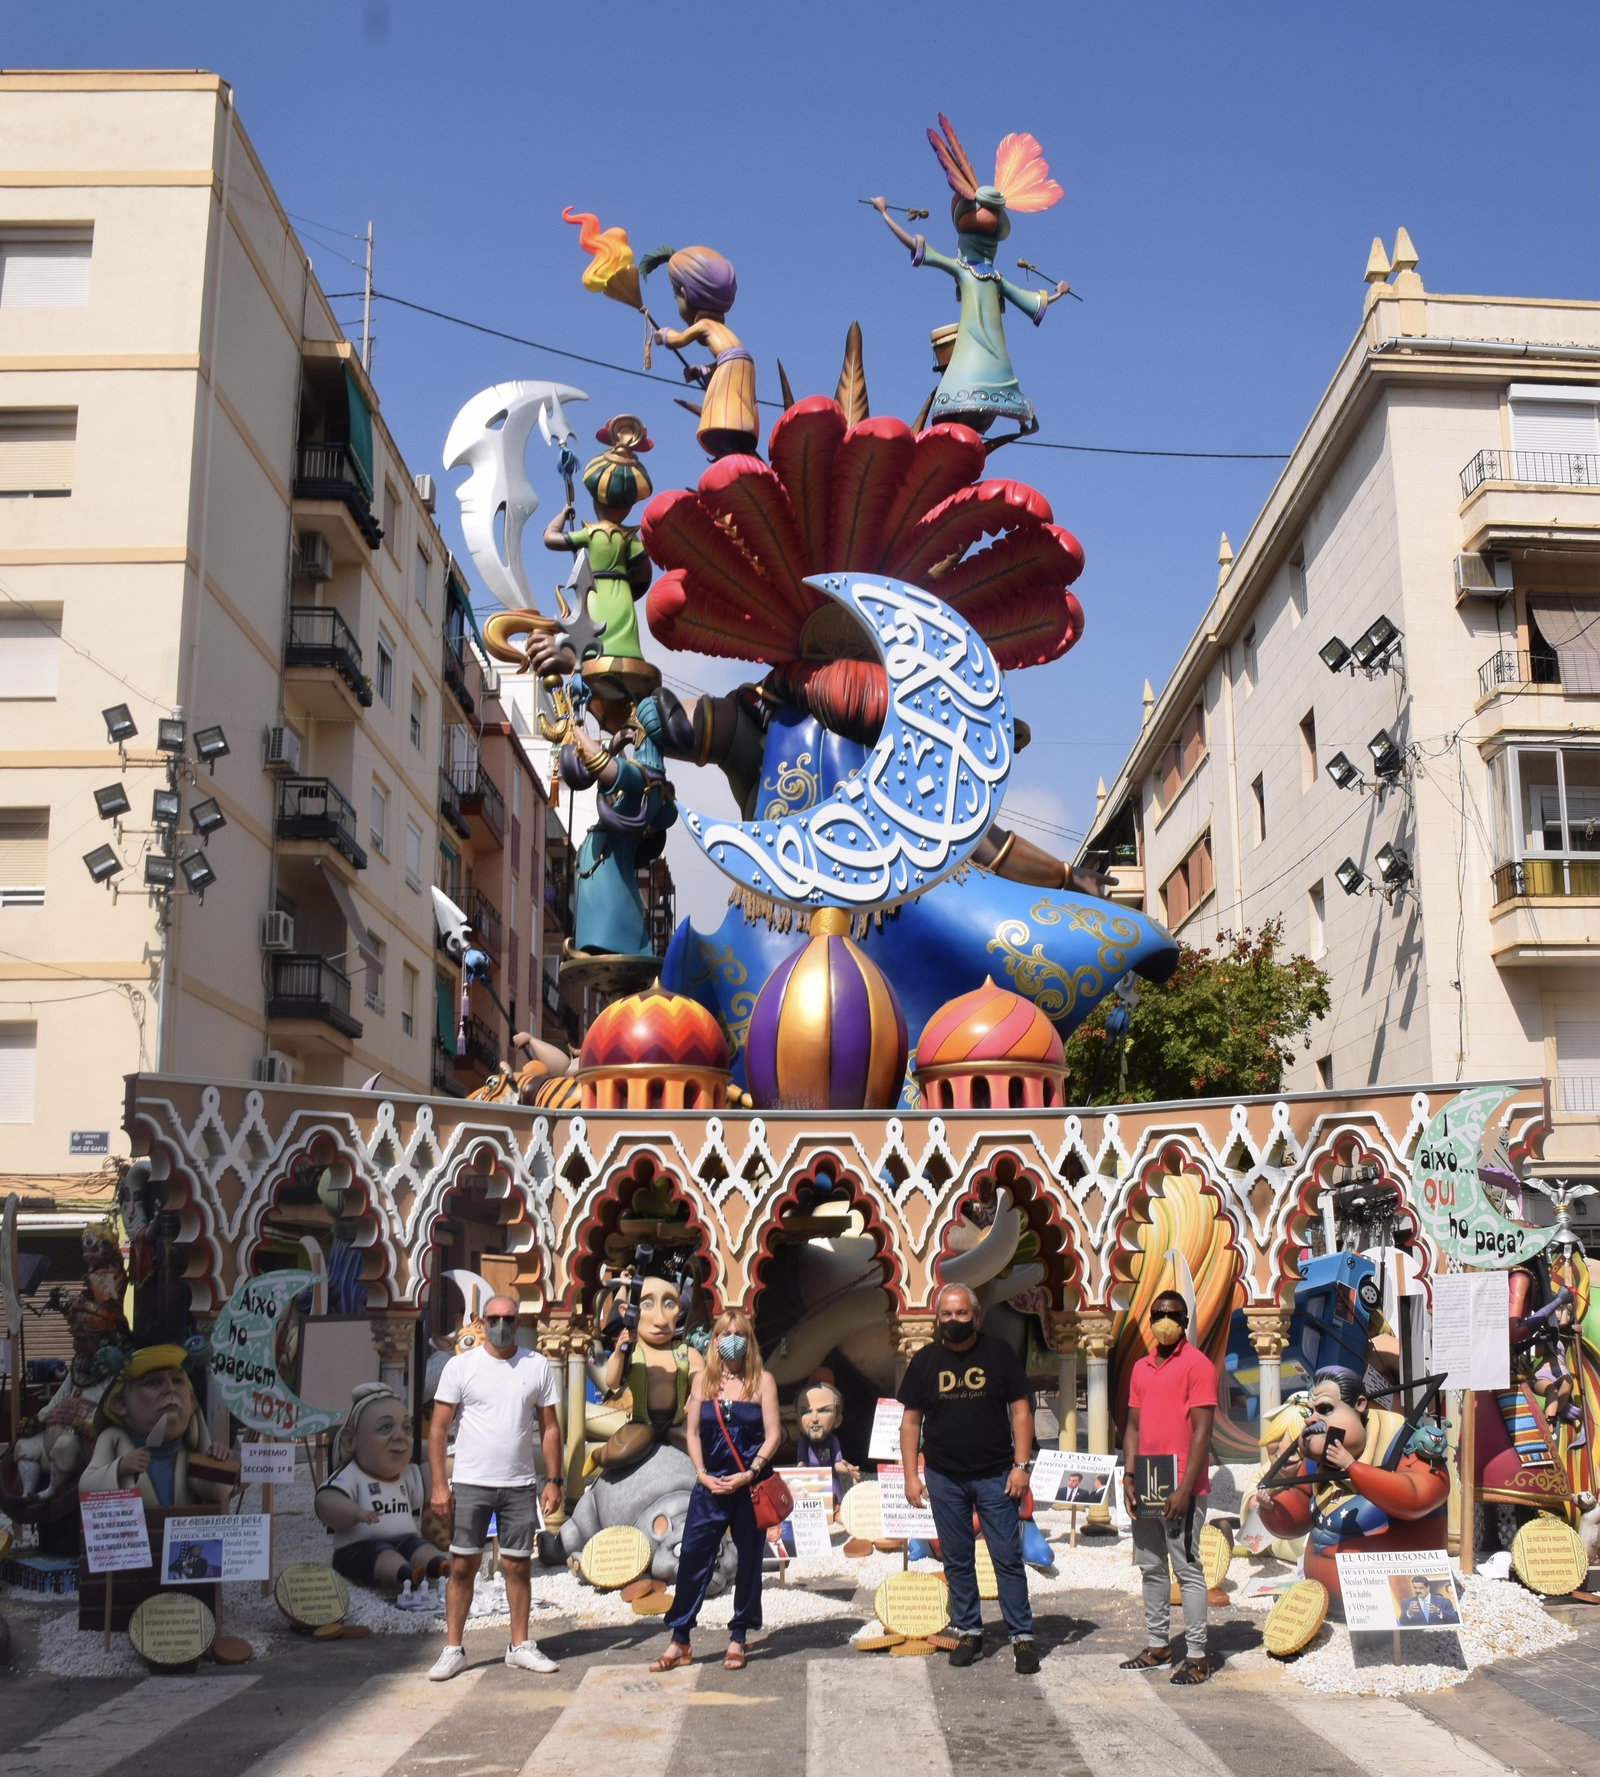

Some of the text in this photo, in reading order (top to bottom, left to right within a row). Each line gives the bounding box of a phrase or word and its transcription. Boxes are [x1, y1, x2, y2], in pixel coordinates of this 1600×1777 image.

[1443, 1113, 1448, 1137] I
[1424, 1178, 1456, 1210] QUI
[1449, 1212, 1524, 1258] ho paga?
[239, 1289, 277, 1318] Això
[228, 1319, 247, 1346] ho
[213, 1352, 276, 1389] paguem
[939, 1370, 956, 1393] D
[964, 1367, 986, 1390] G
[968, 1391, 987, 1400] Gaeta
[252, 1391, 299, 1429] TOTS!
[244, 1465, 274, 1473] SECCIÓN
[1039, 1461, 1069, 1469] ENVIDE
[803, 1501, 822, 1509] HIP!
[223, 1531, 242, 1539] JAMES
[224, 1539, 242, 1547] Donald
[1527, 1547, 1538, 1555] poble
[1342, 1551, 1442, 1563] EL UNIPERSONAL
[1550, 1557, 1575, 1567] descomposta
[1363, 1577, 1386, 1586] Maduro:
[1357, 1590, 1372, 1598] hablo
[154, 1608, 166, 1616] Trump
[1352, 1602, 1365, 1611] VOS
[1365, 1604, 1379, 1613] pone
[1350, 1616, 1356, 1625] el
